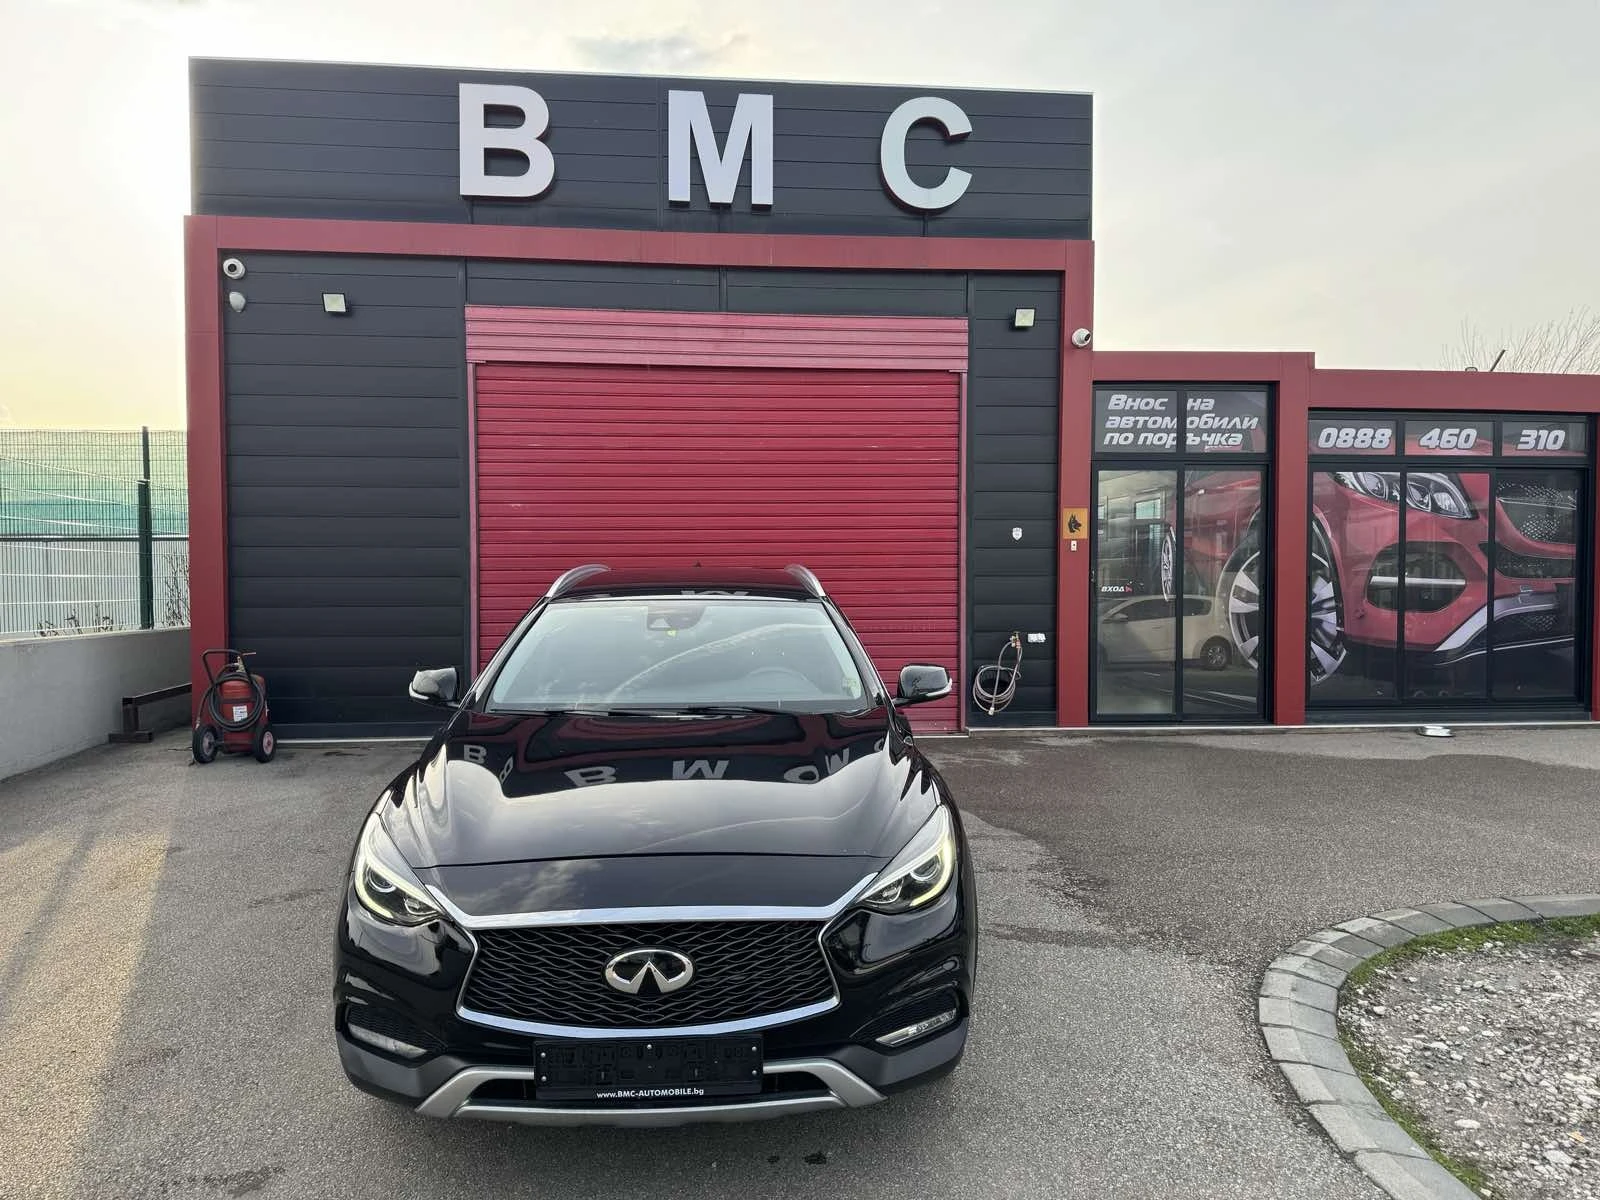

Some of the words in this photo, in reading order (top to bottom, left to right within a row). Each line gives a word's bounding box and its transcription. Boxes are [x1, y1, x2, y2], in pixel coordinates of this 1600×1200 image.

[1108, 394, 1168, 410] Внос
[1187, 398, 1215, 411] на
[1105, 413, 1259, 430] автомобили
[1104, 432, 1134, 445] по
[1138, 432, 1243, 448] поръчка
[1317, 427, 1392, 449] 0888
[1419, 428, 1477, 449] 460
[1517, 429, 1565, 451] 310
[597, 1087, 704, 1098] www.BMC-AUTOMOBILE.bg
